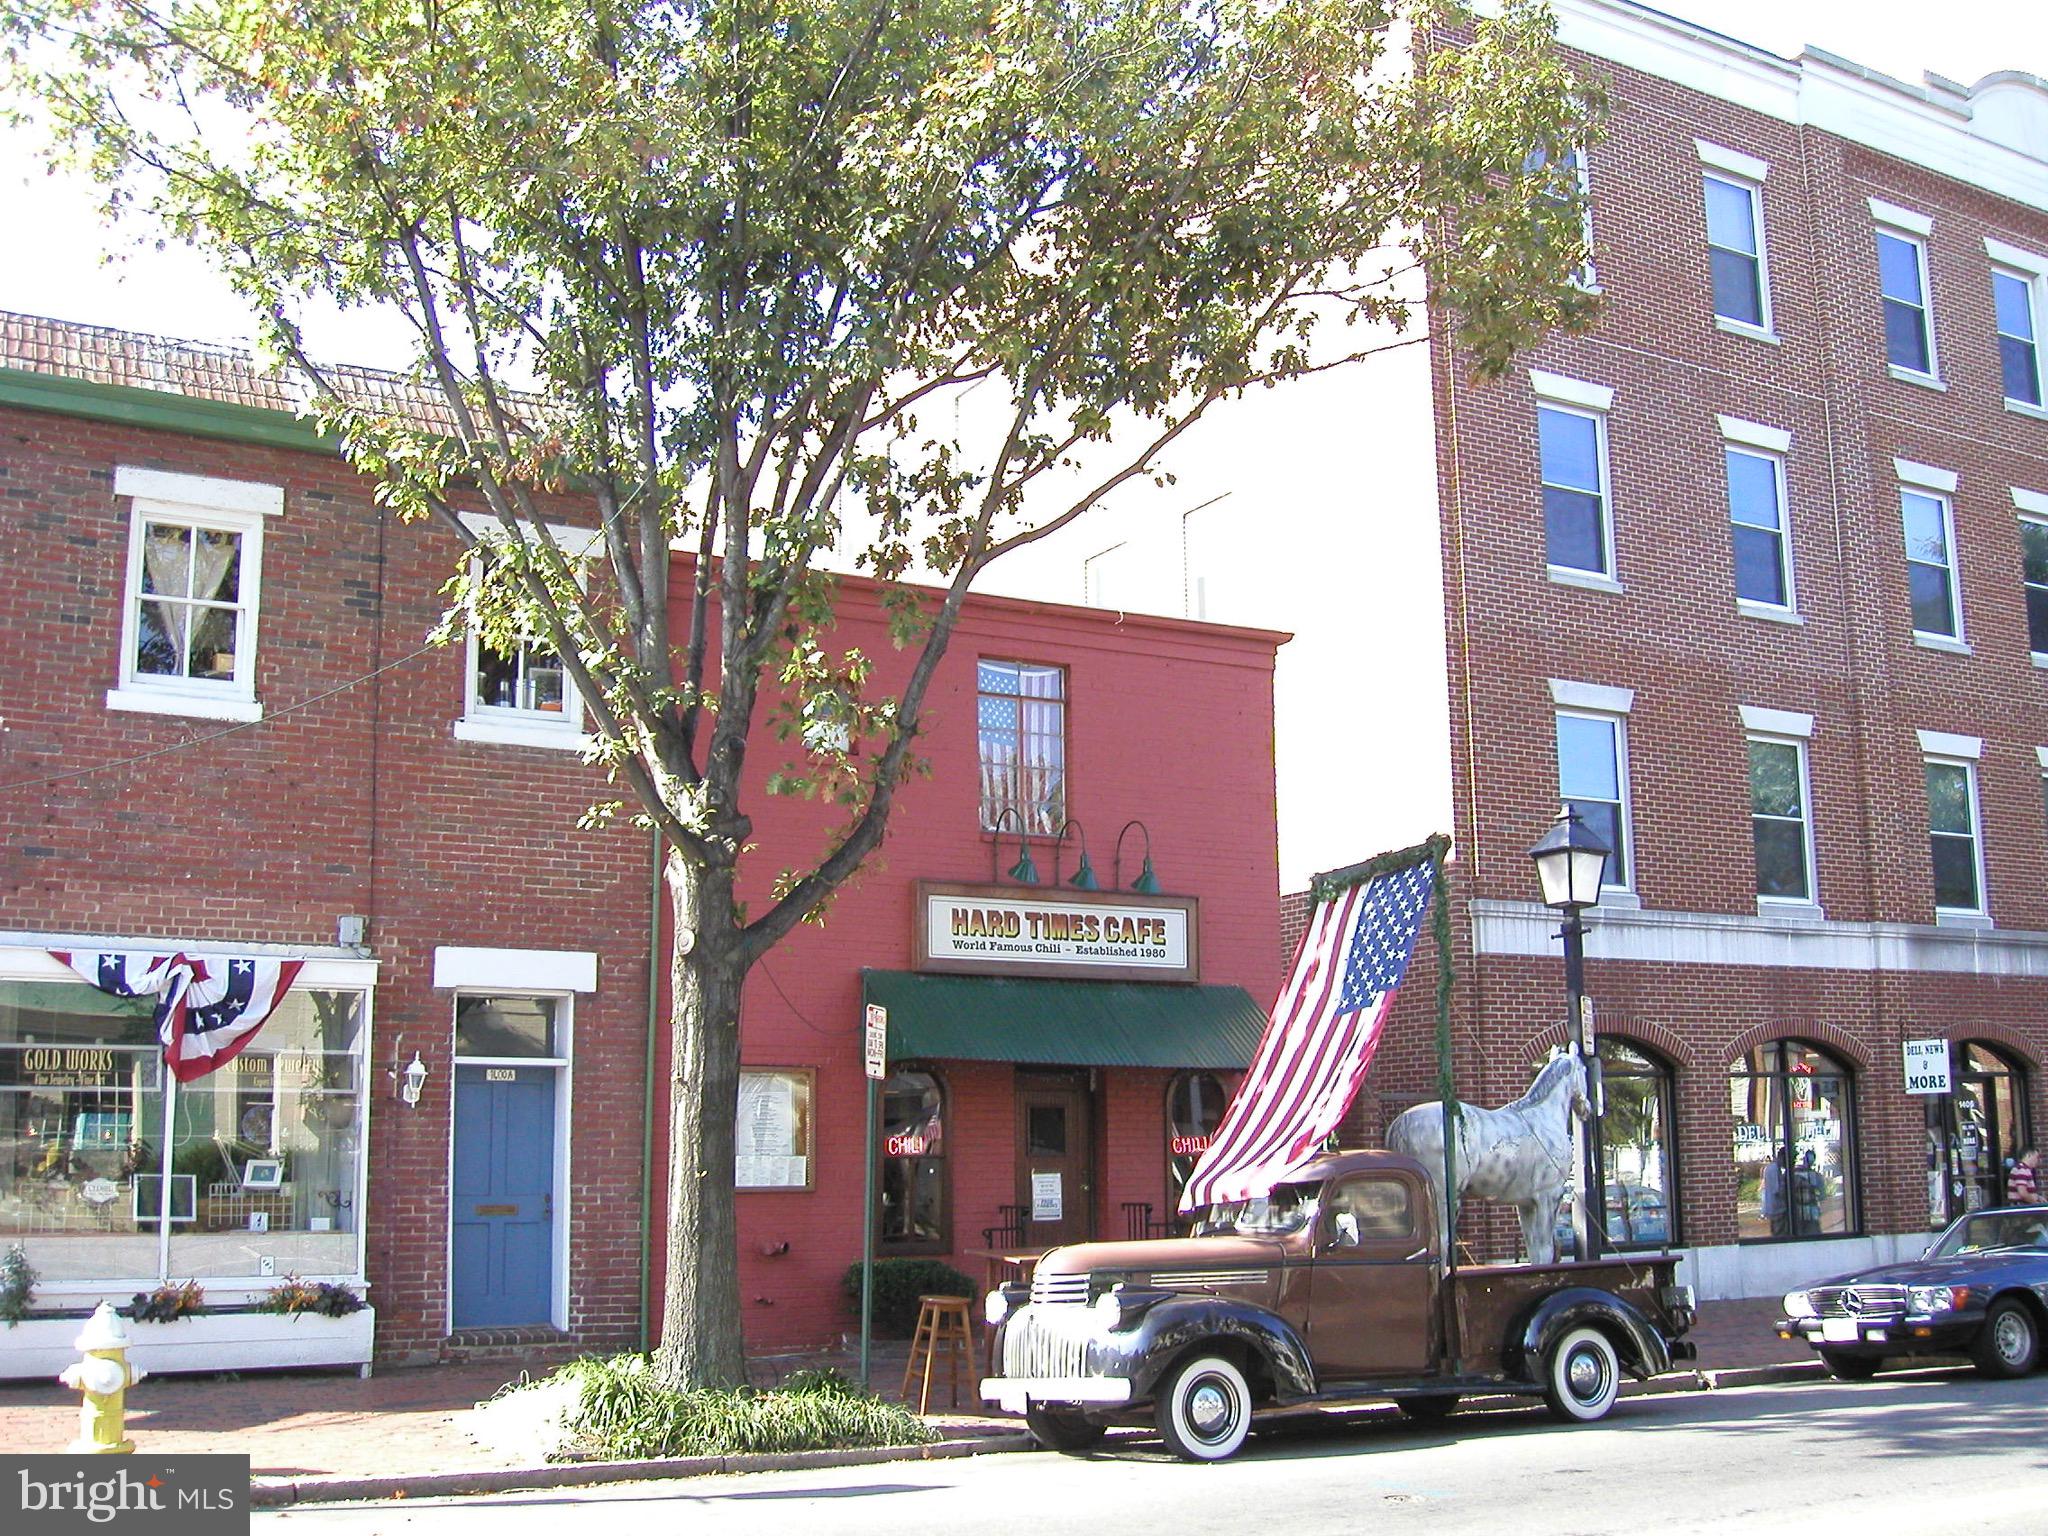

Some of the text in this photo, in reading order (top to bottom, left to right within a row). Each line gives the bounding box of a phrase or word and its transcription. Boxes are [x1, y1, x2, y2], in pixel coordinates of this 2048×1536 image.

[952, 908, 1167, 945] HARD TIMES CAFE
[952, 940, 987, 951] World
[989, 942, 1033, 952] Famous
[1035, 943, 1061, 954] Chili
[1075, 945, 1137, 957] Established
[1140, 948, 1166, 958] 1980
[24, 1049, 113, 1071] GOLD WORKS
[1909, 1075, 1946, 1088] MORE
[888, 1136, 923, 1155] CHILI
[1172, 1136, 1209, 1154] CHILI
